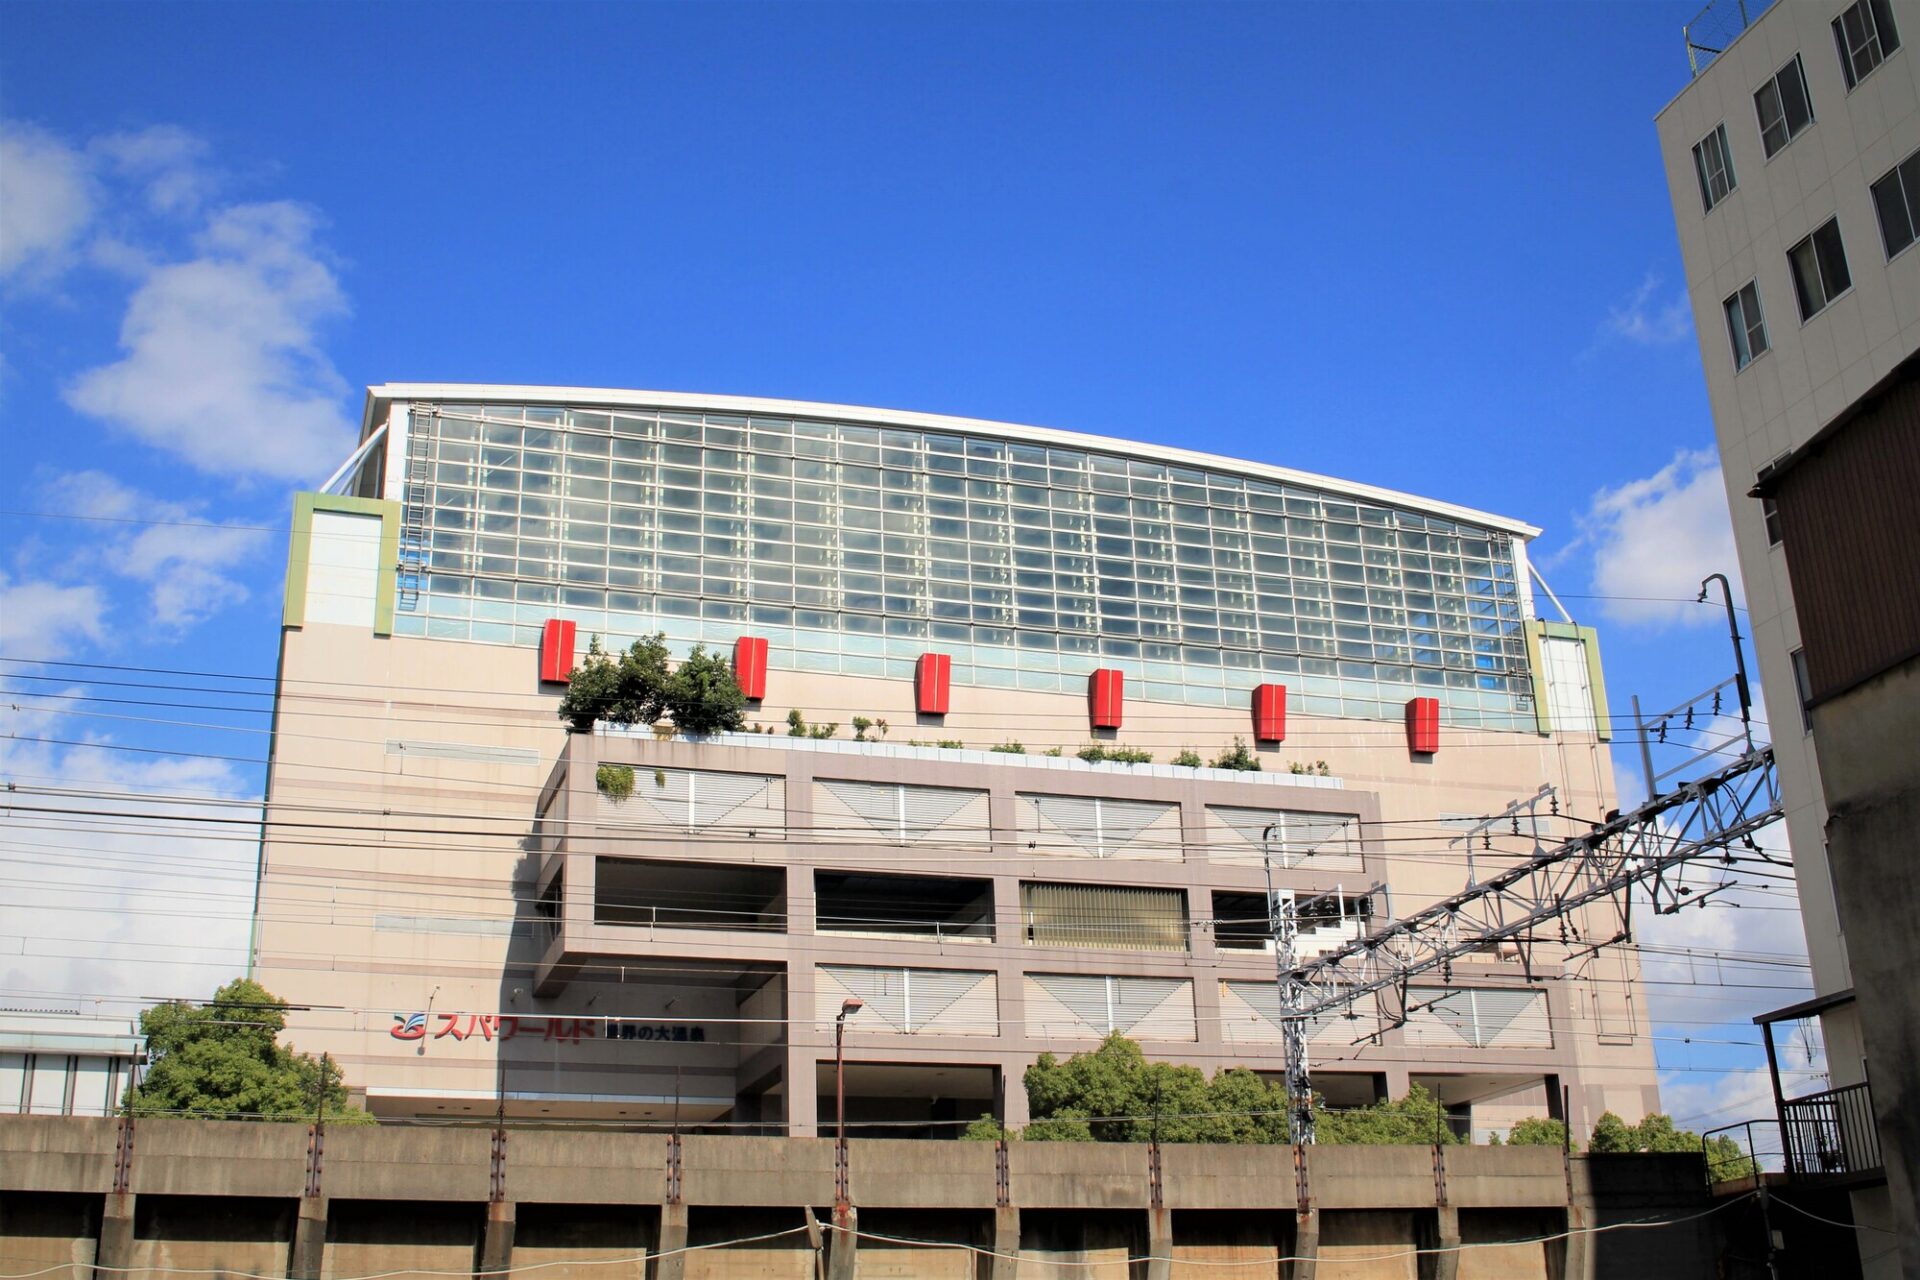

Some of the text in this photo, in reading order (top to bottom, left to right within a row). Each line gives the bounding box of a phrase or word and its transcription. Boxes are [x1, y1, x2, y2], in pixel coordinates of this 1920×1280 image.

[434, 1014, 596, 1044] スパワールド
